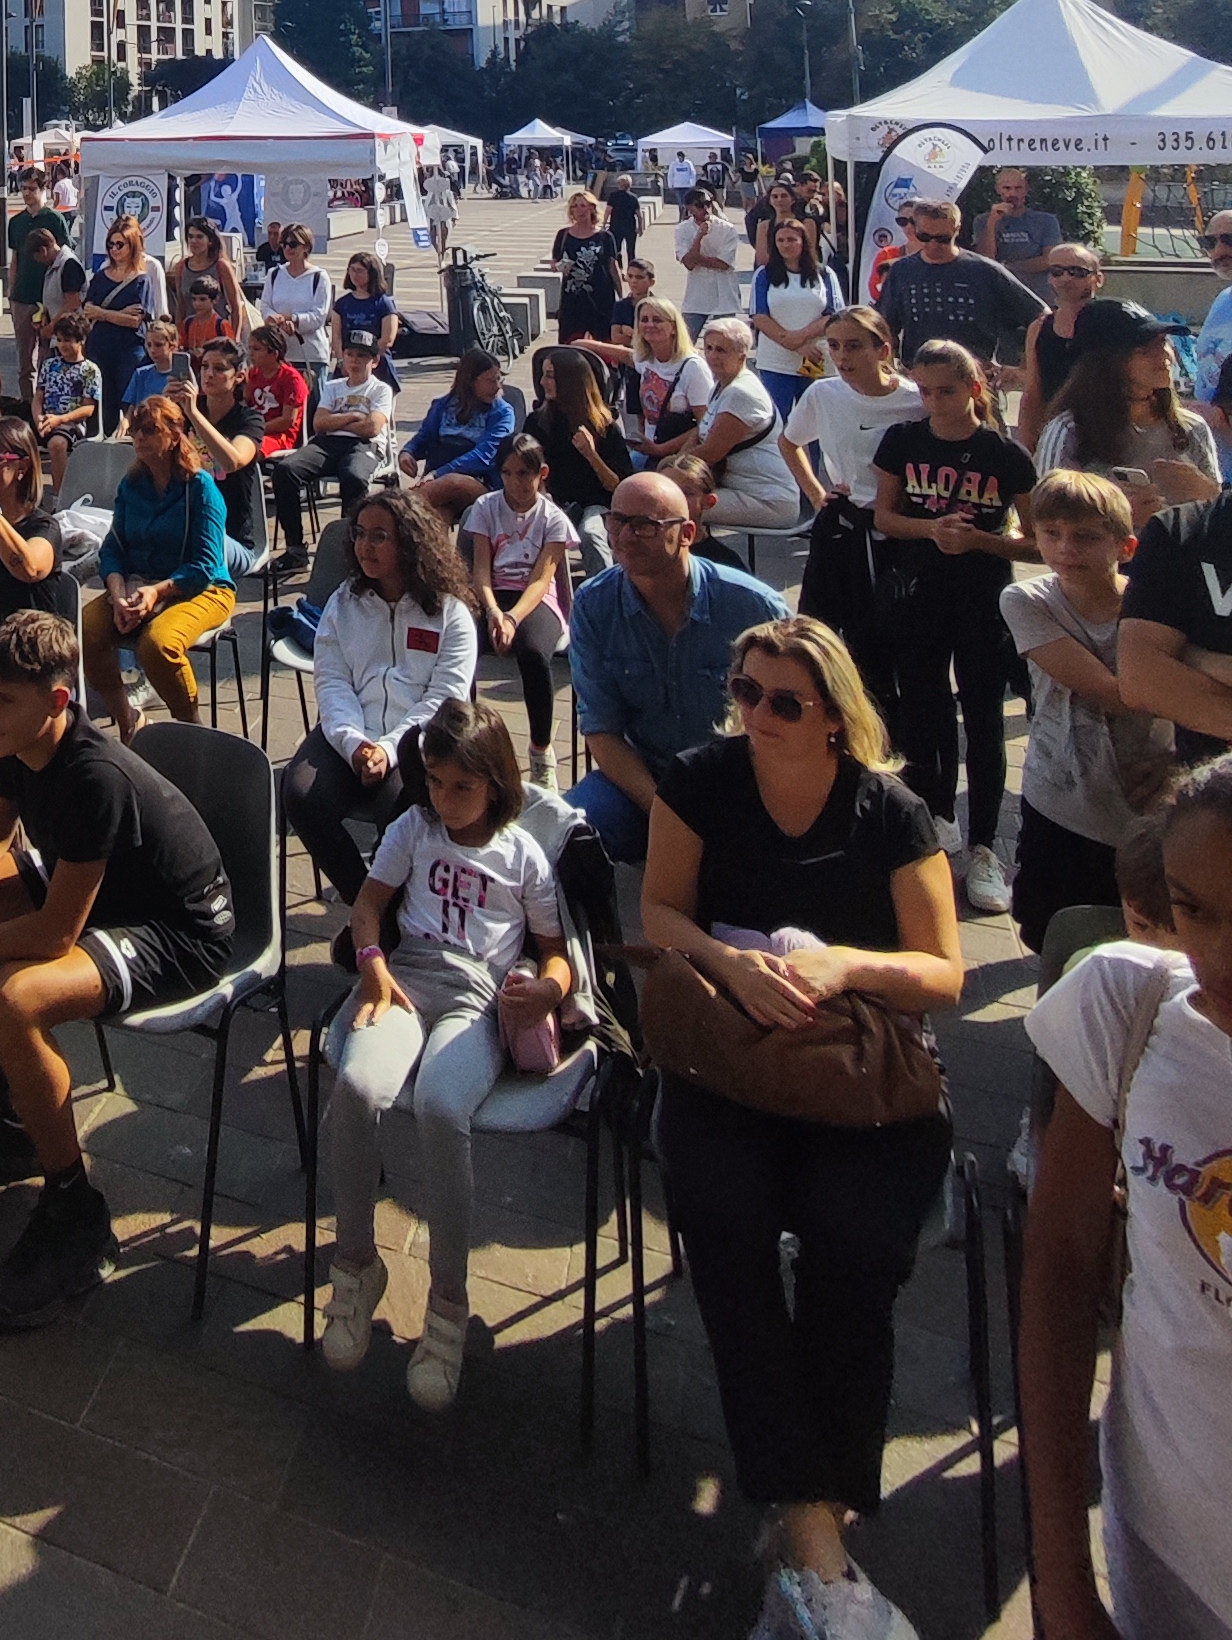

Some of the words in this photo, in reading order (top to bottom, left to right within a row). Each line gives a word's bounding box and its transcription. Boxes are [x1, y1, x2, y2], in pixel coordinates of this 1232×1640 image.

[987, 132, 1109, 152] oltreneve.it
[1157, 131, 1232, 152] 335.61
[118, 179, 158, 199] CORAGGIO
[905, 463, 1003, 508] ALOHA
[428, 859, 496, 909] GET
[441, 899, 474, 940] IT
[1130, 1136, 1232, 1213] Har
